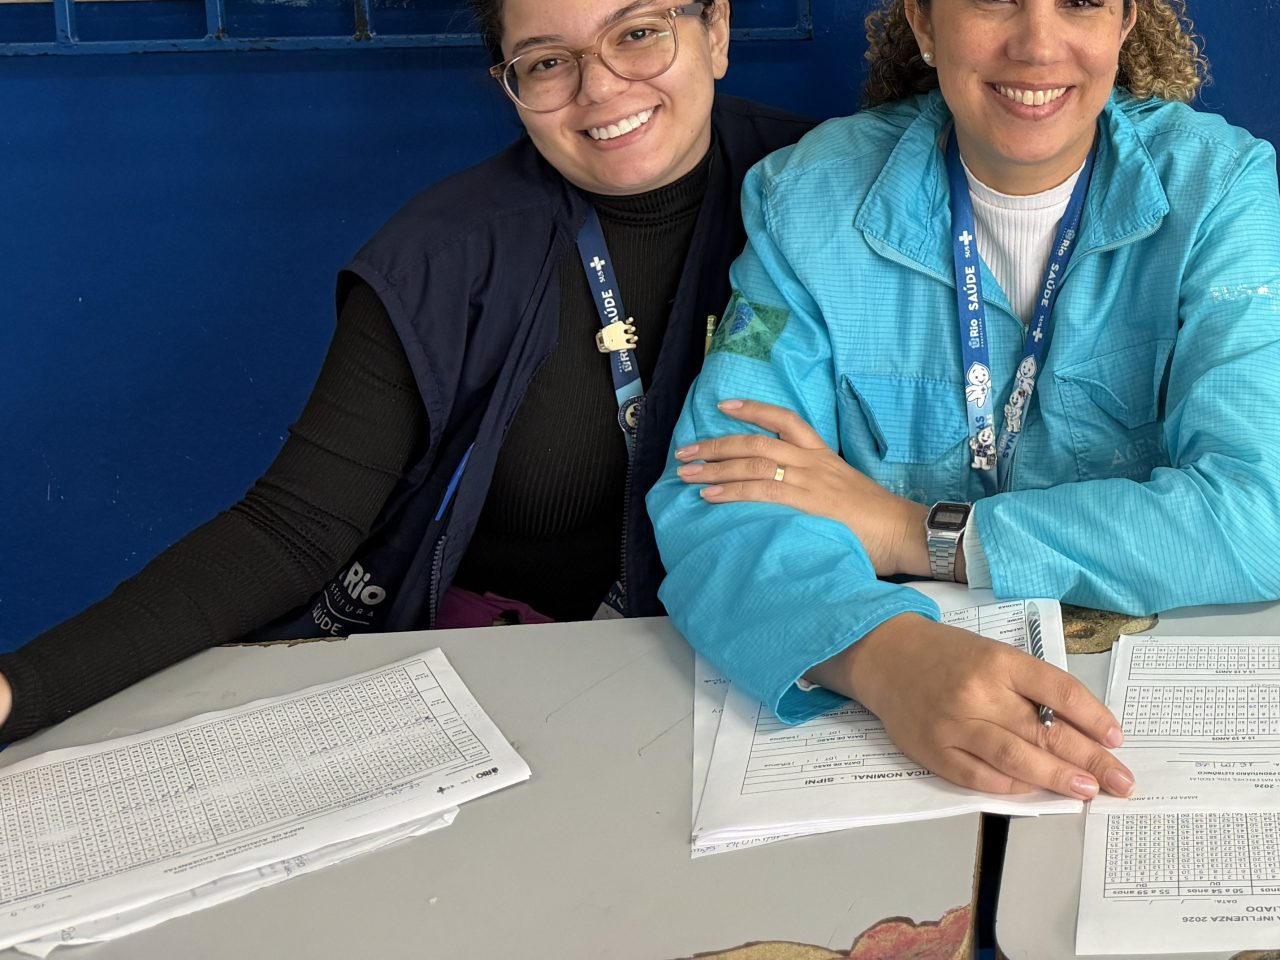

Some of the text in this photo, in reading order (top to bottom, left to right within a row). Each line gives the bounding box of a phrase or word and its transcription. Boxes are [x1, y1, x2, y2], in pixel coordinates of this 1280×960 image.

[963, 265, 980, 312] SAÚDE
[1041, 262, 1060, 308] SAÚDE
[601, 288, 619, 324] AÚDE
[343, 561, 387, 606] Rio
[804, 772, 903, 785] NOMINAL SIPNI
[1210, 915, 1274, 923] INFLUENZA
